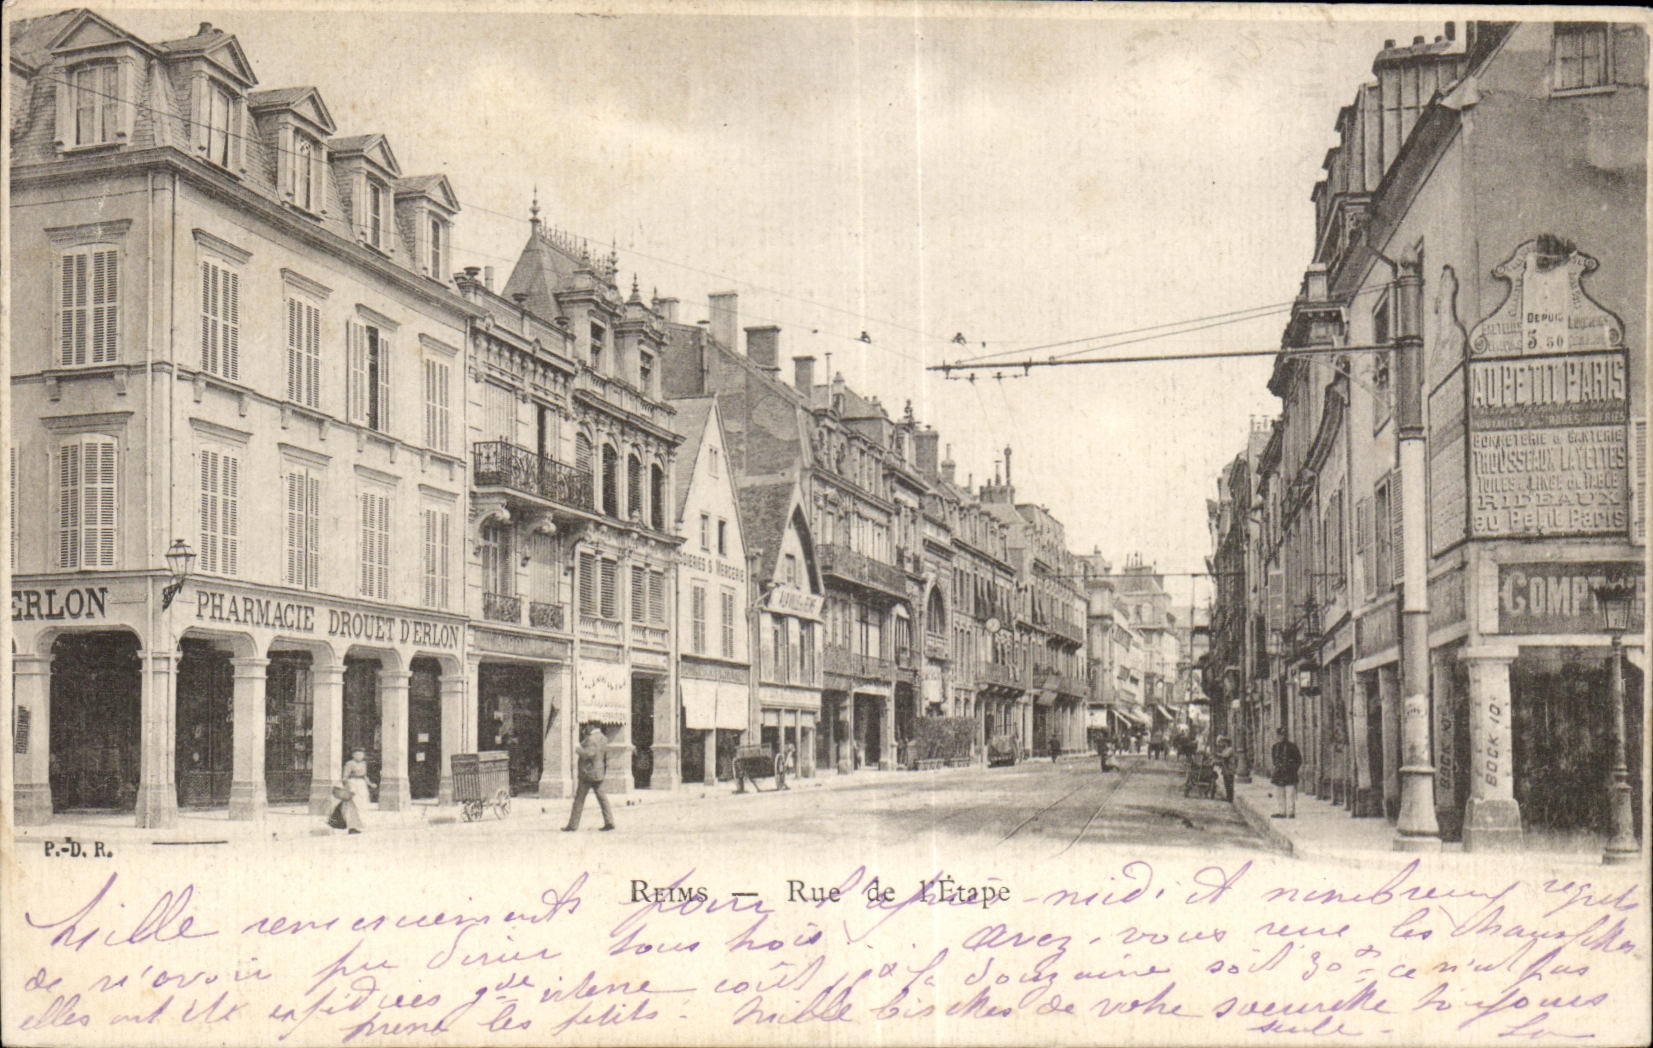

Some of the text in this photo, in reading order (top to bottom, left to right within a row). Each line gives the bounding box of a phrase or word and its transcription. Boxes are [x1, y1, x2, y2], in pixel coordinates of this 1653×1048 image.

[1472, 358, 1624, 408] AU PETIT PARIS
[1473, 446, 1625, 475] TROUSSEAUX LAYETTES
[1478, 492, 1621, 511] RIDEAUX
[1569, 508, 1625, 529] Paris
[196, 589, 315, 633] PHARMACIE
[328, 608, 396, 642] DROUET
[400, 619, 459, 649] D'ERLON
[1485, 733, 1499, 787] BOCK
[25, 967, 63, 992] de
[1390, 907, 1434, 941] les
[1035, 993, 1075, 1016] de
